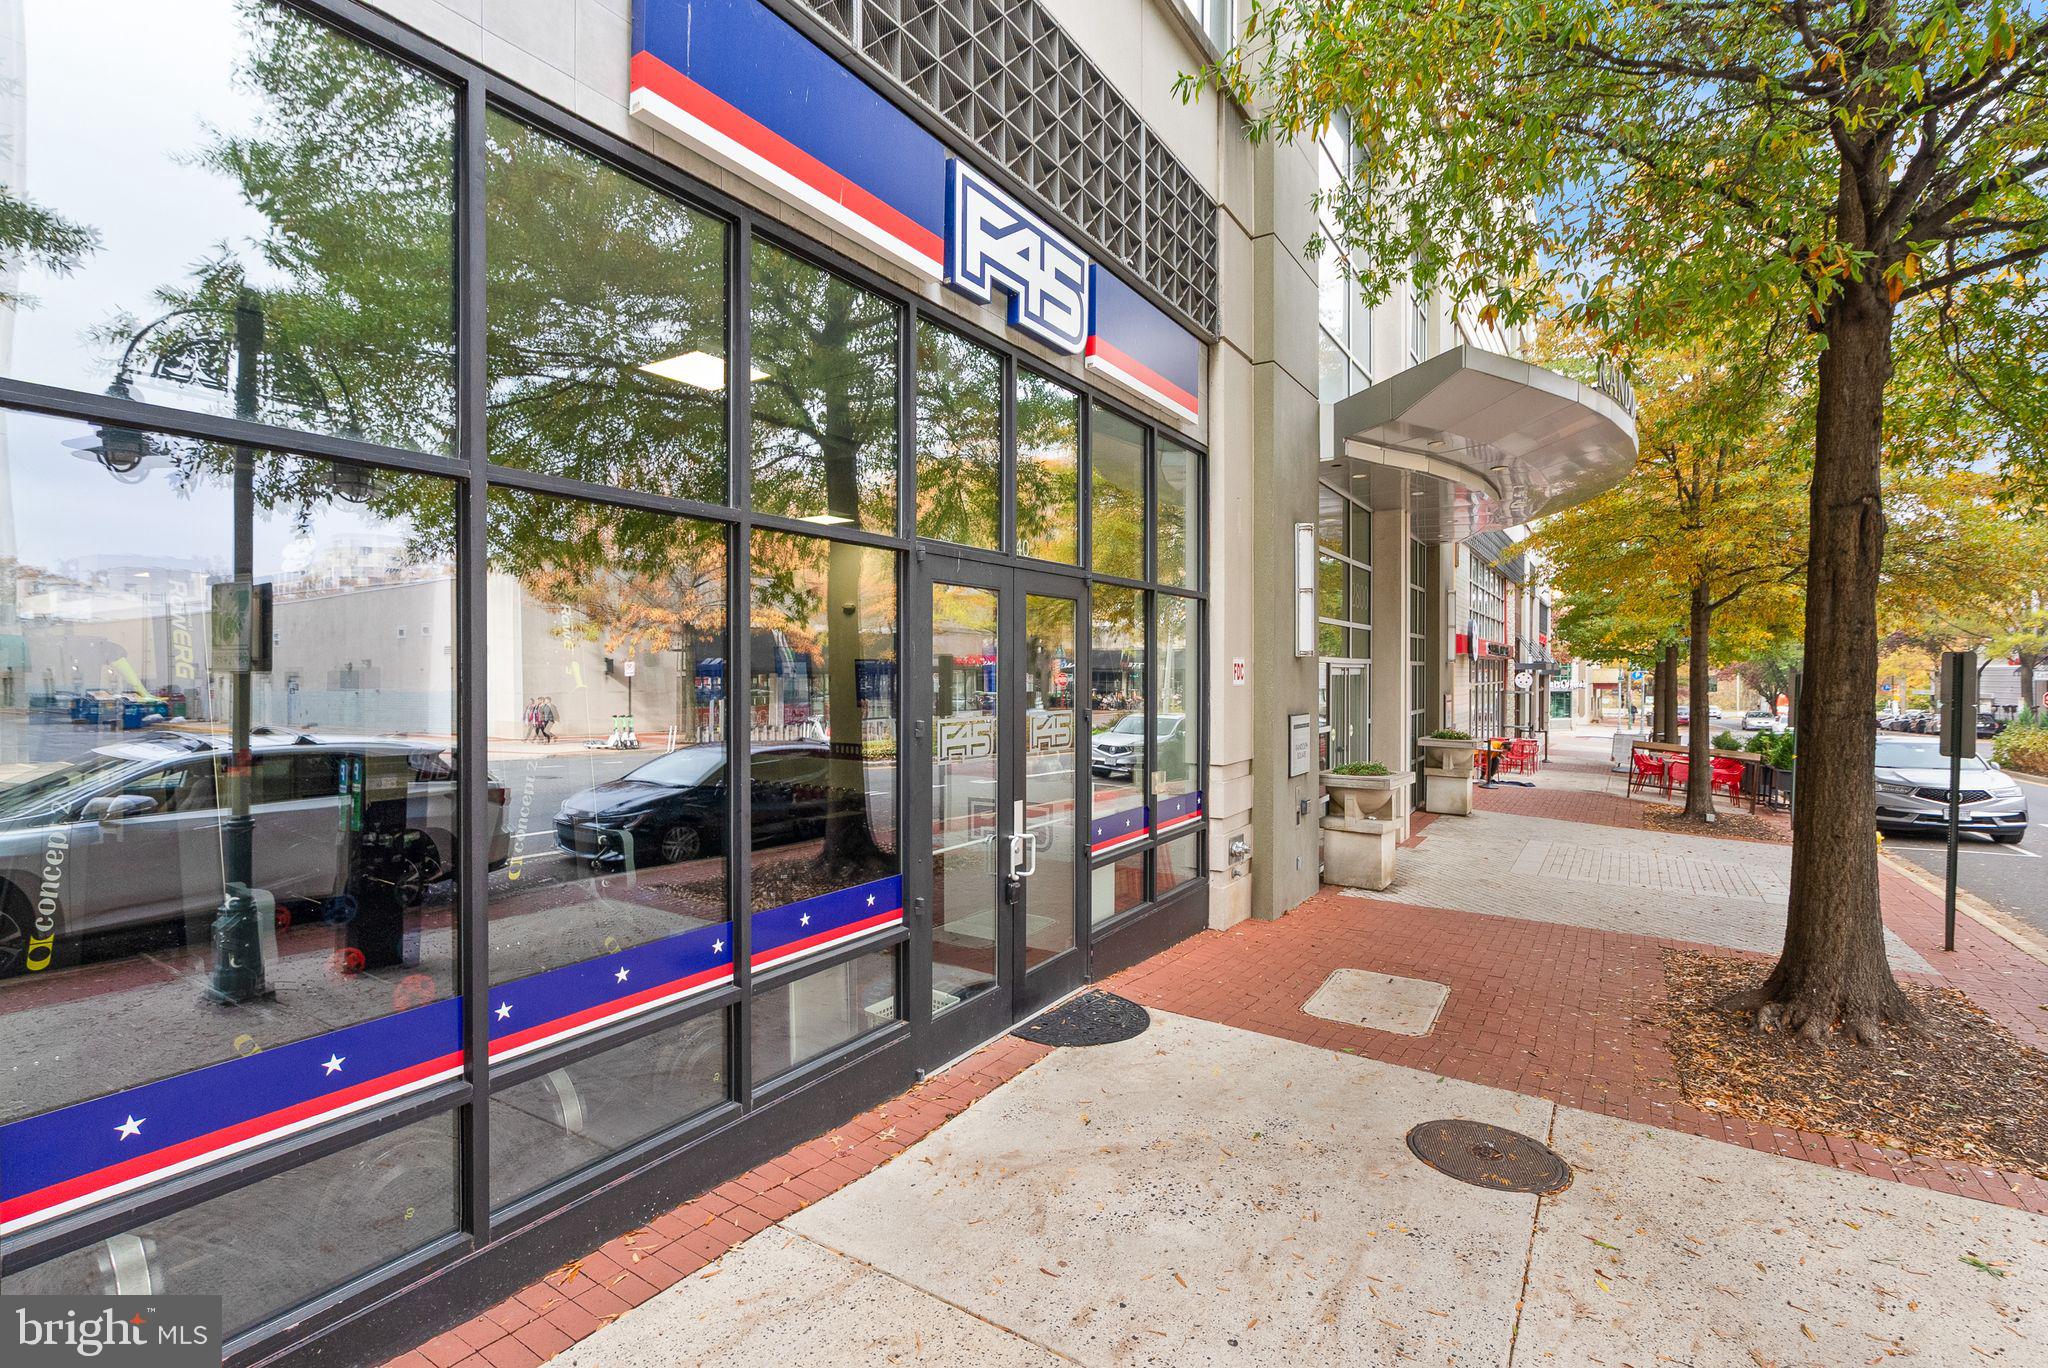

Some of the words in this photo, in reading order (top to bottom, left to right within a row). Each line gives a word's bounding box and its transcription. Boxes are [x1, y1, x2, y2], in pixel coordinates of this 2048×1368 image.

[963, 181, 1084, 342] F45
[1233, 662, 1245, 681] FDC
[941, 721, 993, 760] F45
[1031, 714, 1072, 749] F45
[35, 817, 69, 932] concep
